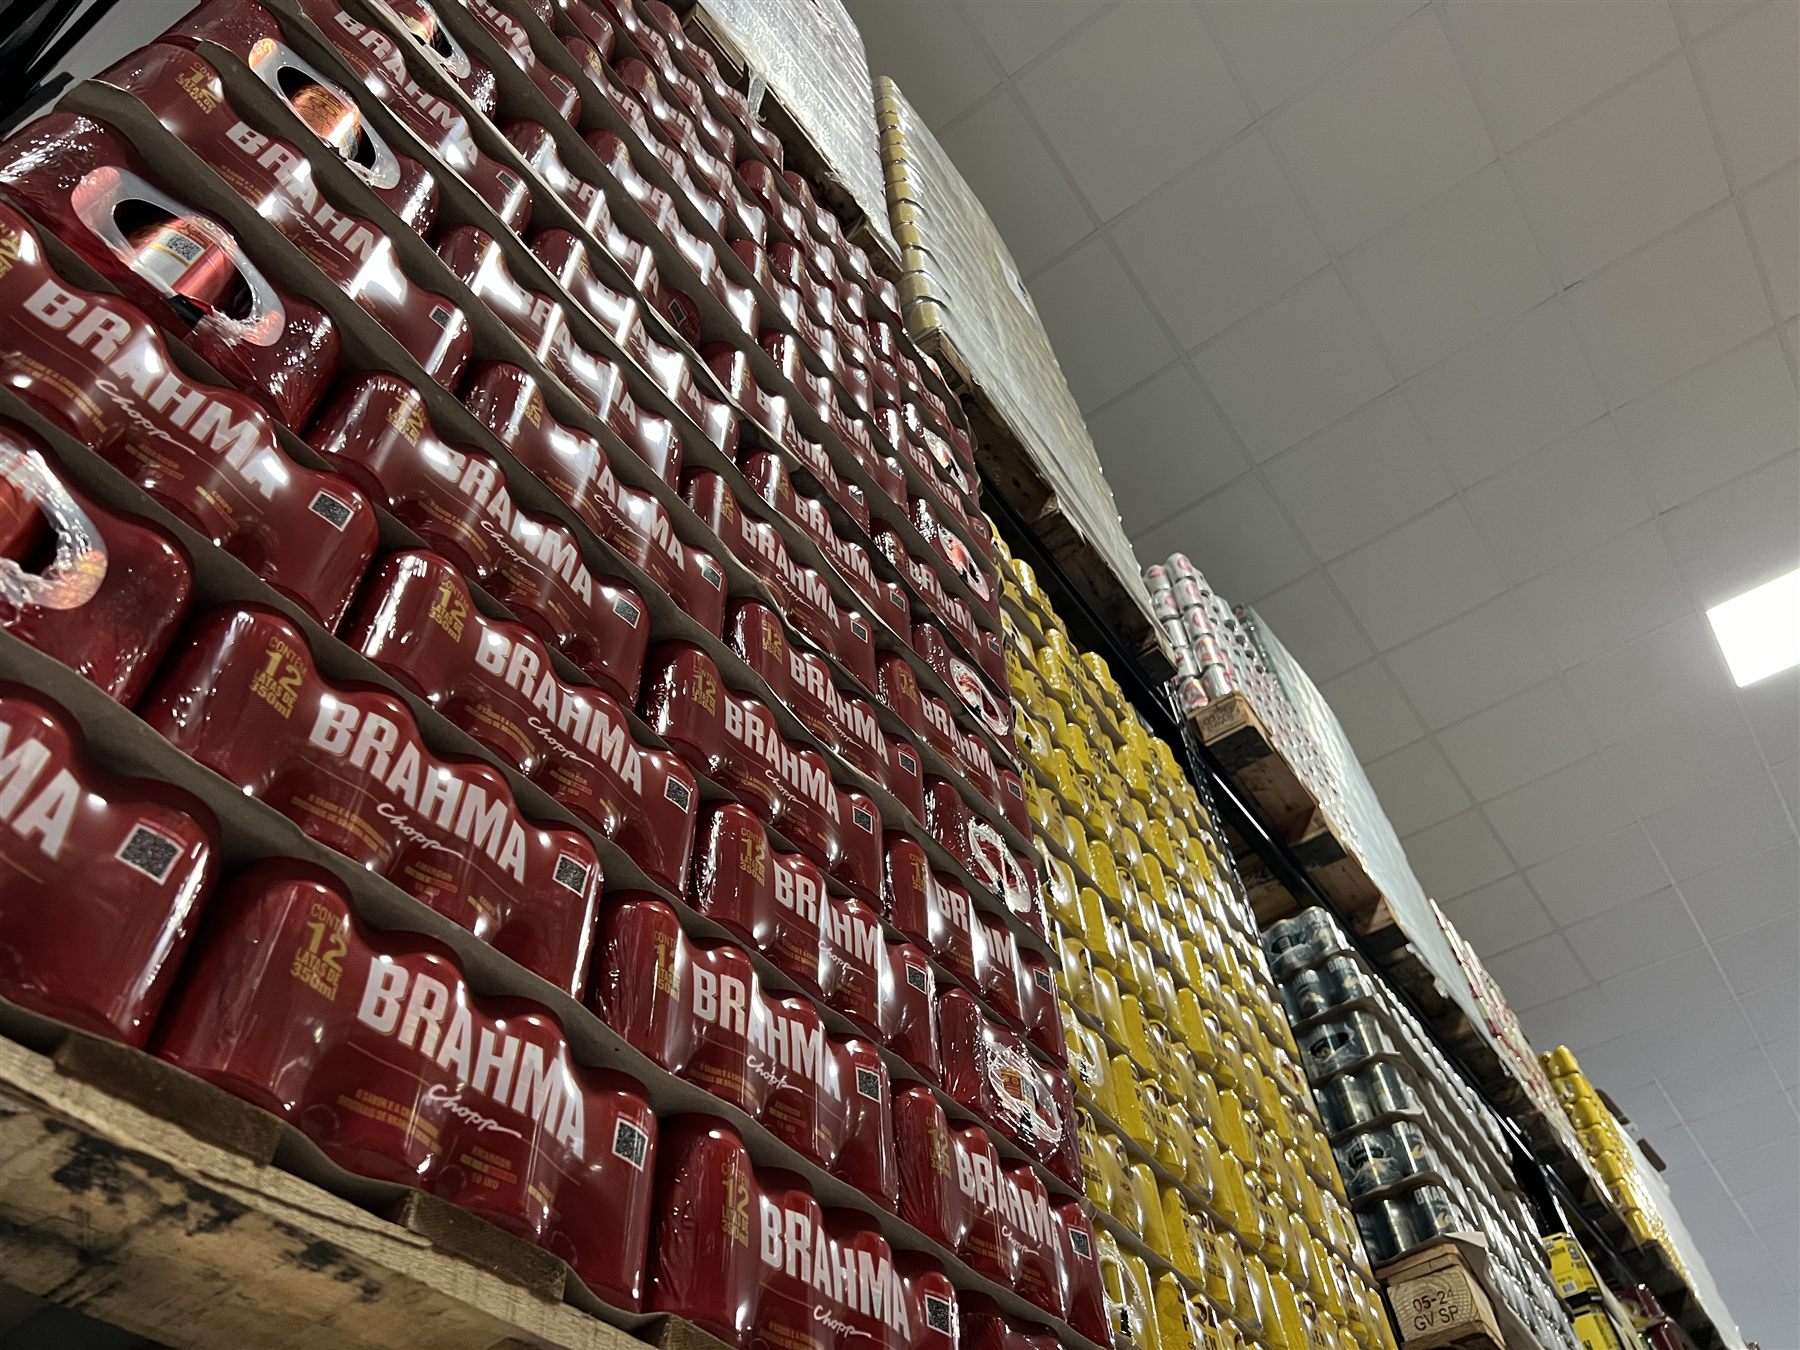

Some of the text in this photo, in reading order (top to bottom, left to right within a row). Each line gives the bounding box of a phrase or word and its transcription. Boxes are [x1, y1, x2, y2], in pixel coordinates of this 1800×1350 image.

[334, 10, 478, 166] BRAHMA
[22, 278, 289, 500] BRAHMA
[94, 378, 196, 455] Chopp
[480, 520, 546, 575] Chopp
[741, 513, 840, 630] BRAHMA
[795, 493, 881, 600] BRAHMA
[438, 586, 467, 627] 12
[249, 681, 292, 719] 350ml
[254, 668, 297, 709] LATAS DE
[265, 649, 303, 697] 12
[475, 626, 642, 797] BRAHMA
[788, 648, 889, 767] BRAHMA
[528, 716, 595, 768] Chopp
[724, 695, 841, 825] BRAHMA
[919, 691, 1001, 791] BRAHMA
[308, 697, 527, 885] BRAHMA
[765, 769, 810, 808] Chopp
[376, 802, 464, 859] Chopp
[294, 946, 343, 988] LATAS DE
[305, 919, 349, 972] 12
[290, 961, 337, 1002] 350ml
[357, 956, 585, 1163] BRAHMA
[746, 1055, 804, 1094] Chopp
[427, 1083, 523, 1139] Chopp
[722, 1178, 750, 1219] 12
[758, 1195, 912, 1343] BRAHMA
[813, 1304, 872, 1339] Chopp
[1413, 1304, 1459, 1331] GV SP
